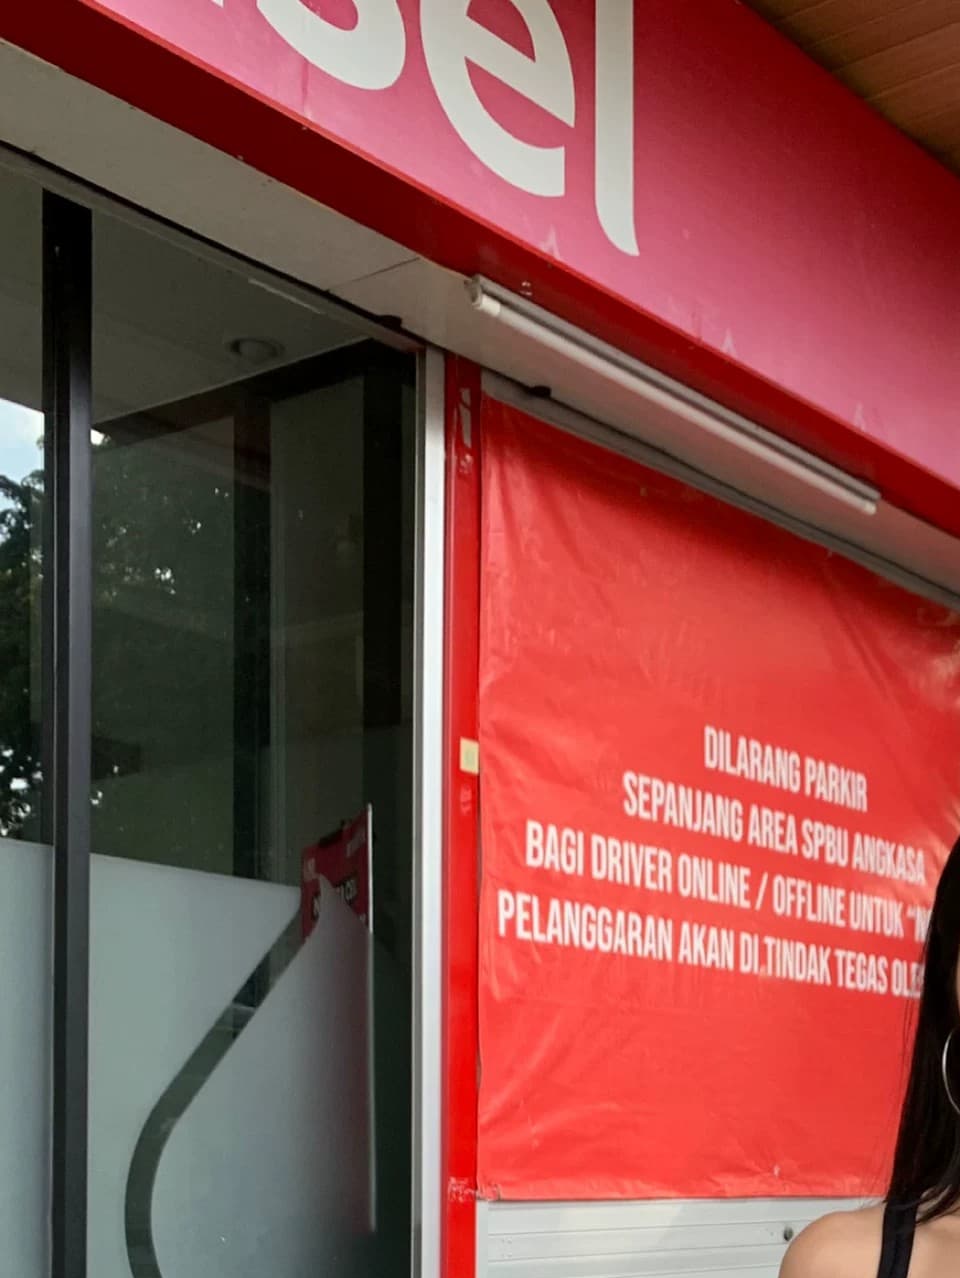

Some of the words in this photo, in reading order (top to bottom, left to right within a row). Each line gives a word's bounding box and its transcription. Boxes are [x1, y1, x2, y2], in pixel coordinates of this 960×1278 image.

[704, 725, 801, 794] DILARANG
[804, 756, 868, 812] PARKIR
[525, 818, 584, 877] BAGI
[591, 833, 673, 891] DRIVER
[677, 852, 751, 910] ONLINE
[755, 871, 769, 911] /
[773, 873, 847, 928] OFFLINE
[849, 891, 905, 939] UNTUK
[622, 770, 743, 843] SEPANJANG
[747, 803, 798, 855] AREA
[801, 819, 849, 867] SPBU
[851, 832, 927, 886] ANGKASA
[497, 889, 673, 961] PELANGGARAN
[677, 922, 735, 971] AKAN
[834, 946, 889, 995] TEGAS
[891, 957, 925, 999] OLE
